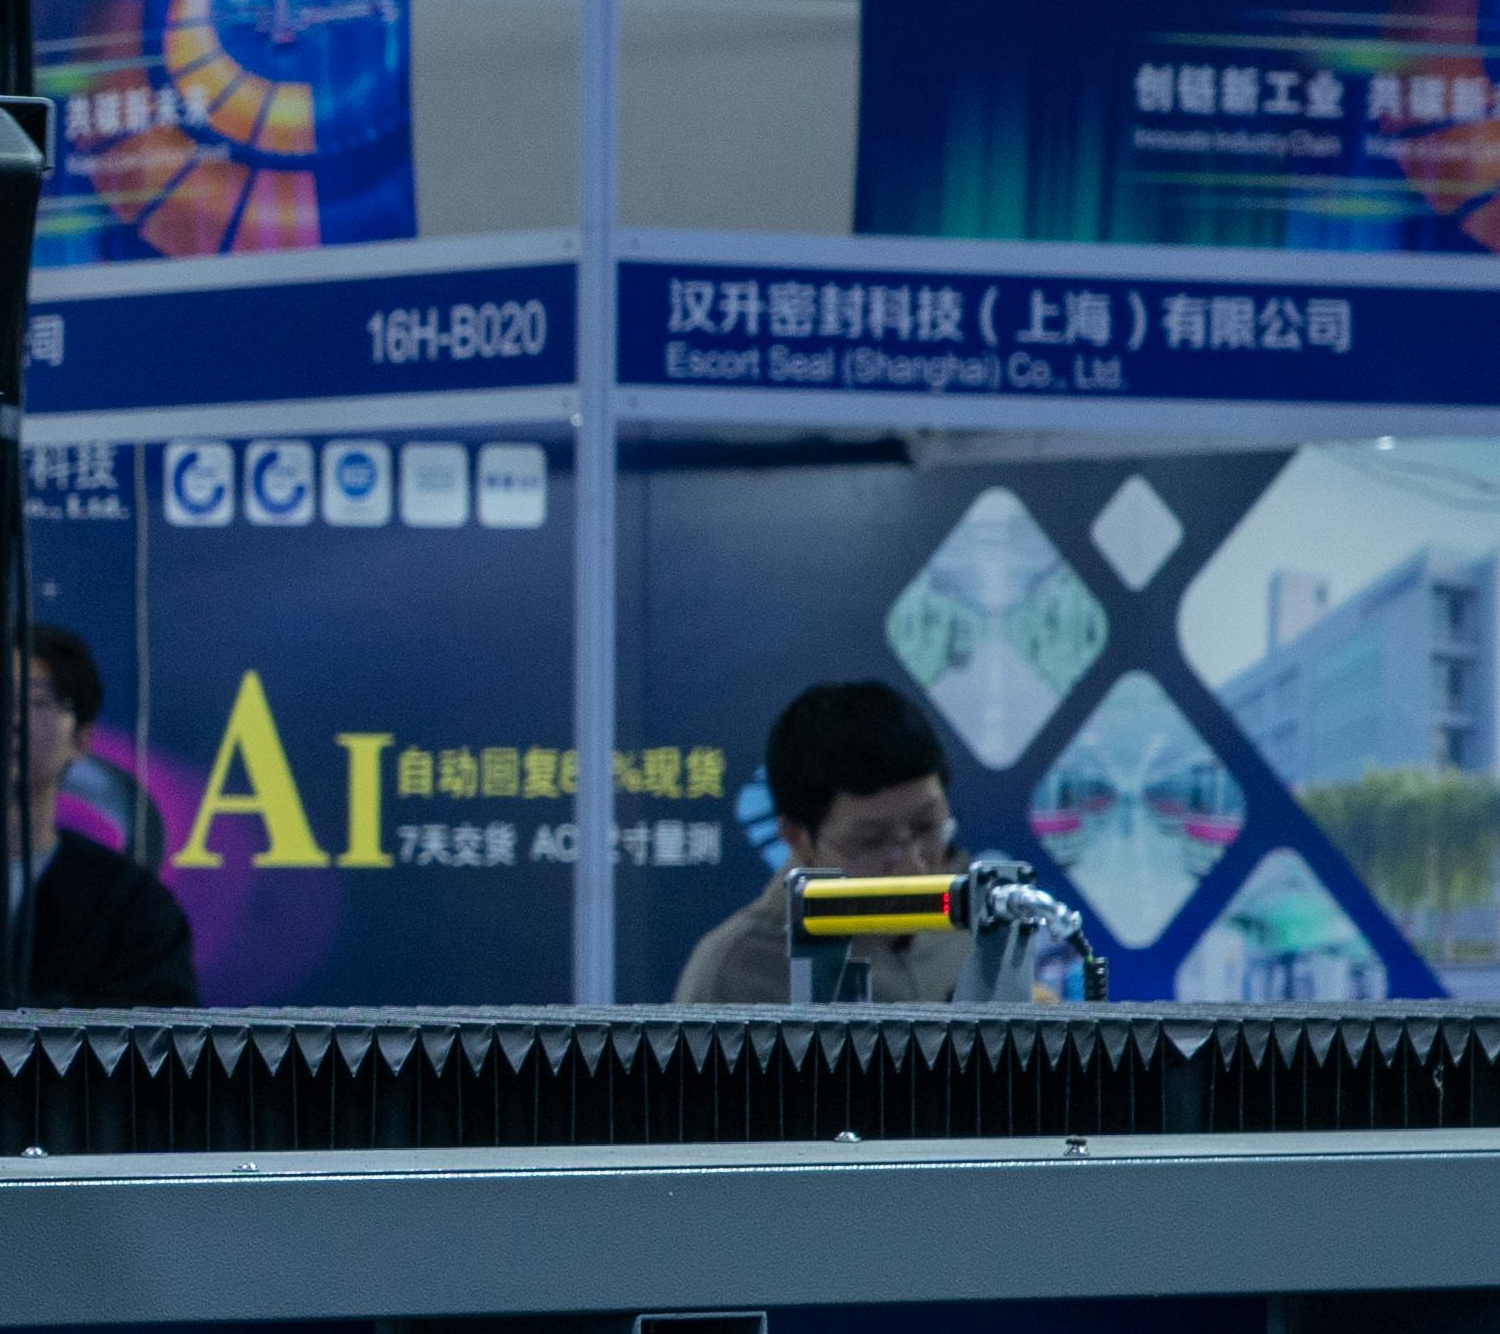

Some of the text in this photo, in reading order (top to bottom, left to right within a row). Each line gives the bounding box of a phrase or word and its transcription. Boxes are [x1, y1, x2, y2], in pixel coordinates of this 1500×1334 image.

[21, 315, 65, 367] 司
[366, 299, 548, 364] 16H-B020
[666, 342, 760, 381] Escort
[767, 344, 835, 382] Seal
[843, 347, 998, 393] (Shanghai)
[171, 668, 395, 868] AI
